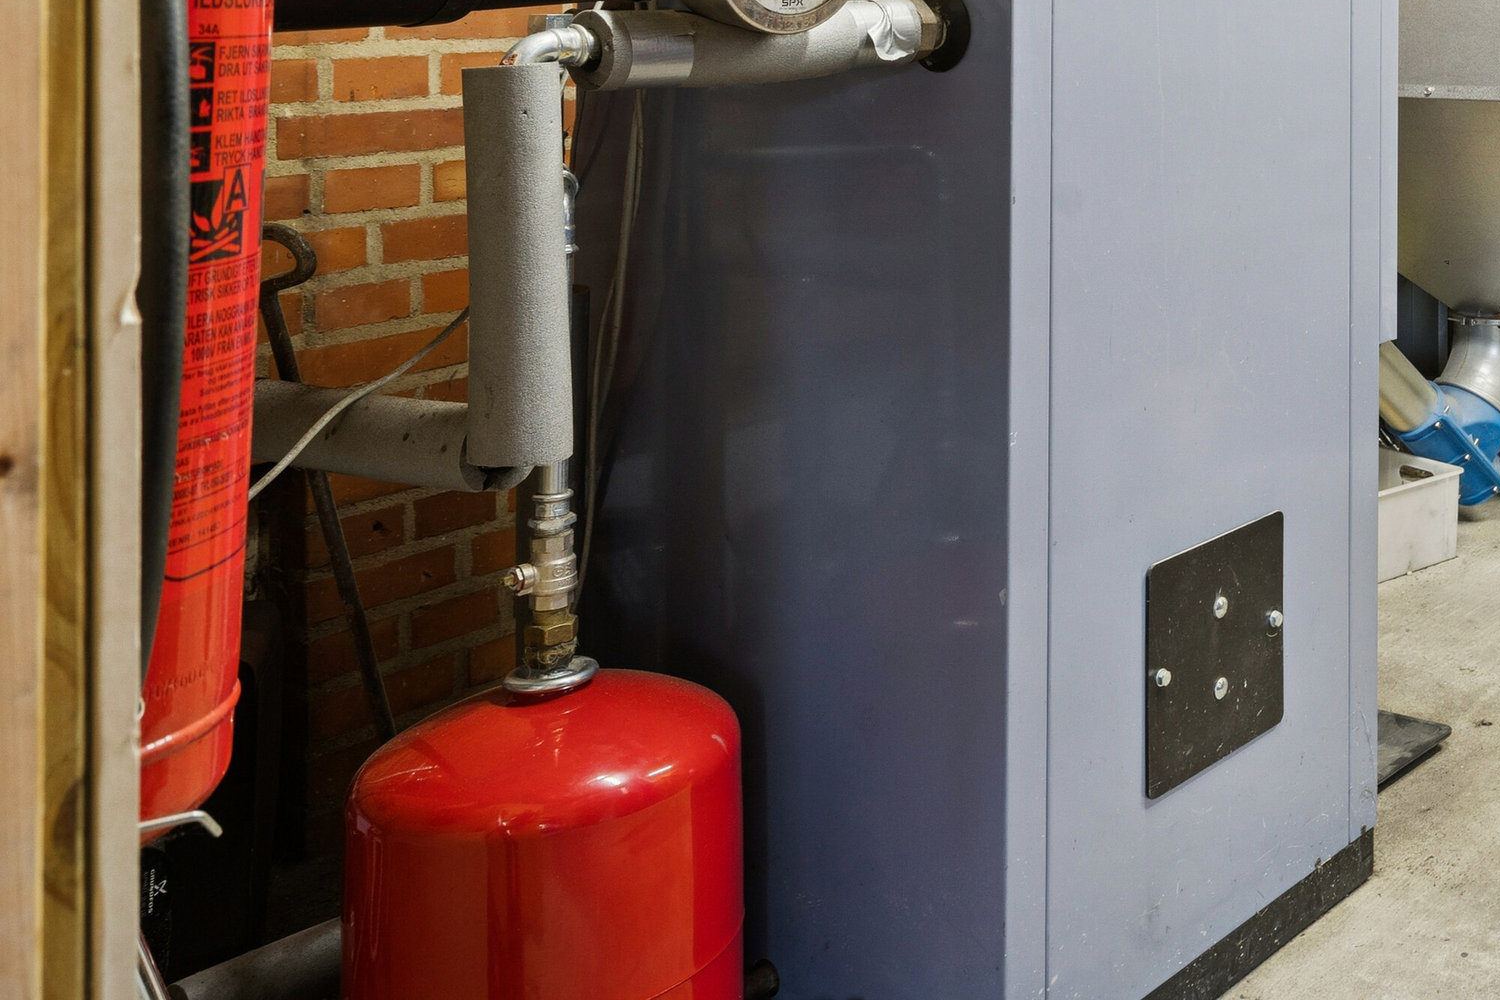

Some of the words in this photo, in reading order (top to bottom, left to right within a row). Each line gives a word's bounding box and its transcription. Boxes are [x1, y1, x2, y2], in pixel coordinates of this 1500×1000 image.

[198, 23, 219, 35] 34A
[219, 45, 250, 60] FJERN
[217, 62, 240, 78] DRA
[242, 61, 252, 76] UT
[217, 90, 238, 105] RET
[216, 107, 245, 123] RIKTA
[215, 132, 243, 149] KLEM
[215, 150, 247, 167] TRYCK
[226, 168, 248, 211] A
[187, 286, 214, 306] TRISK
